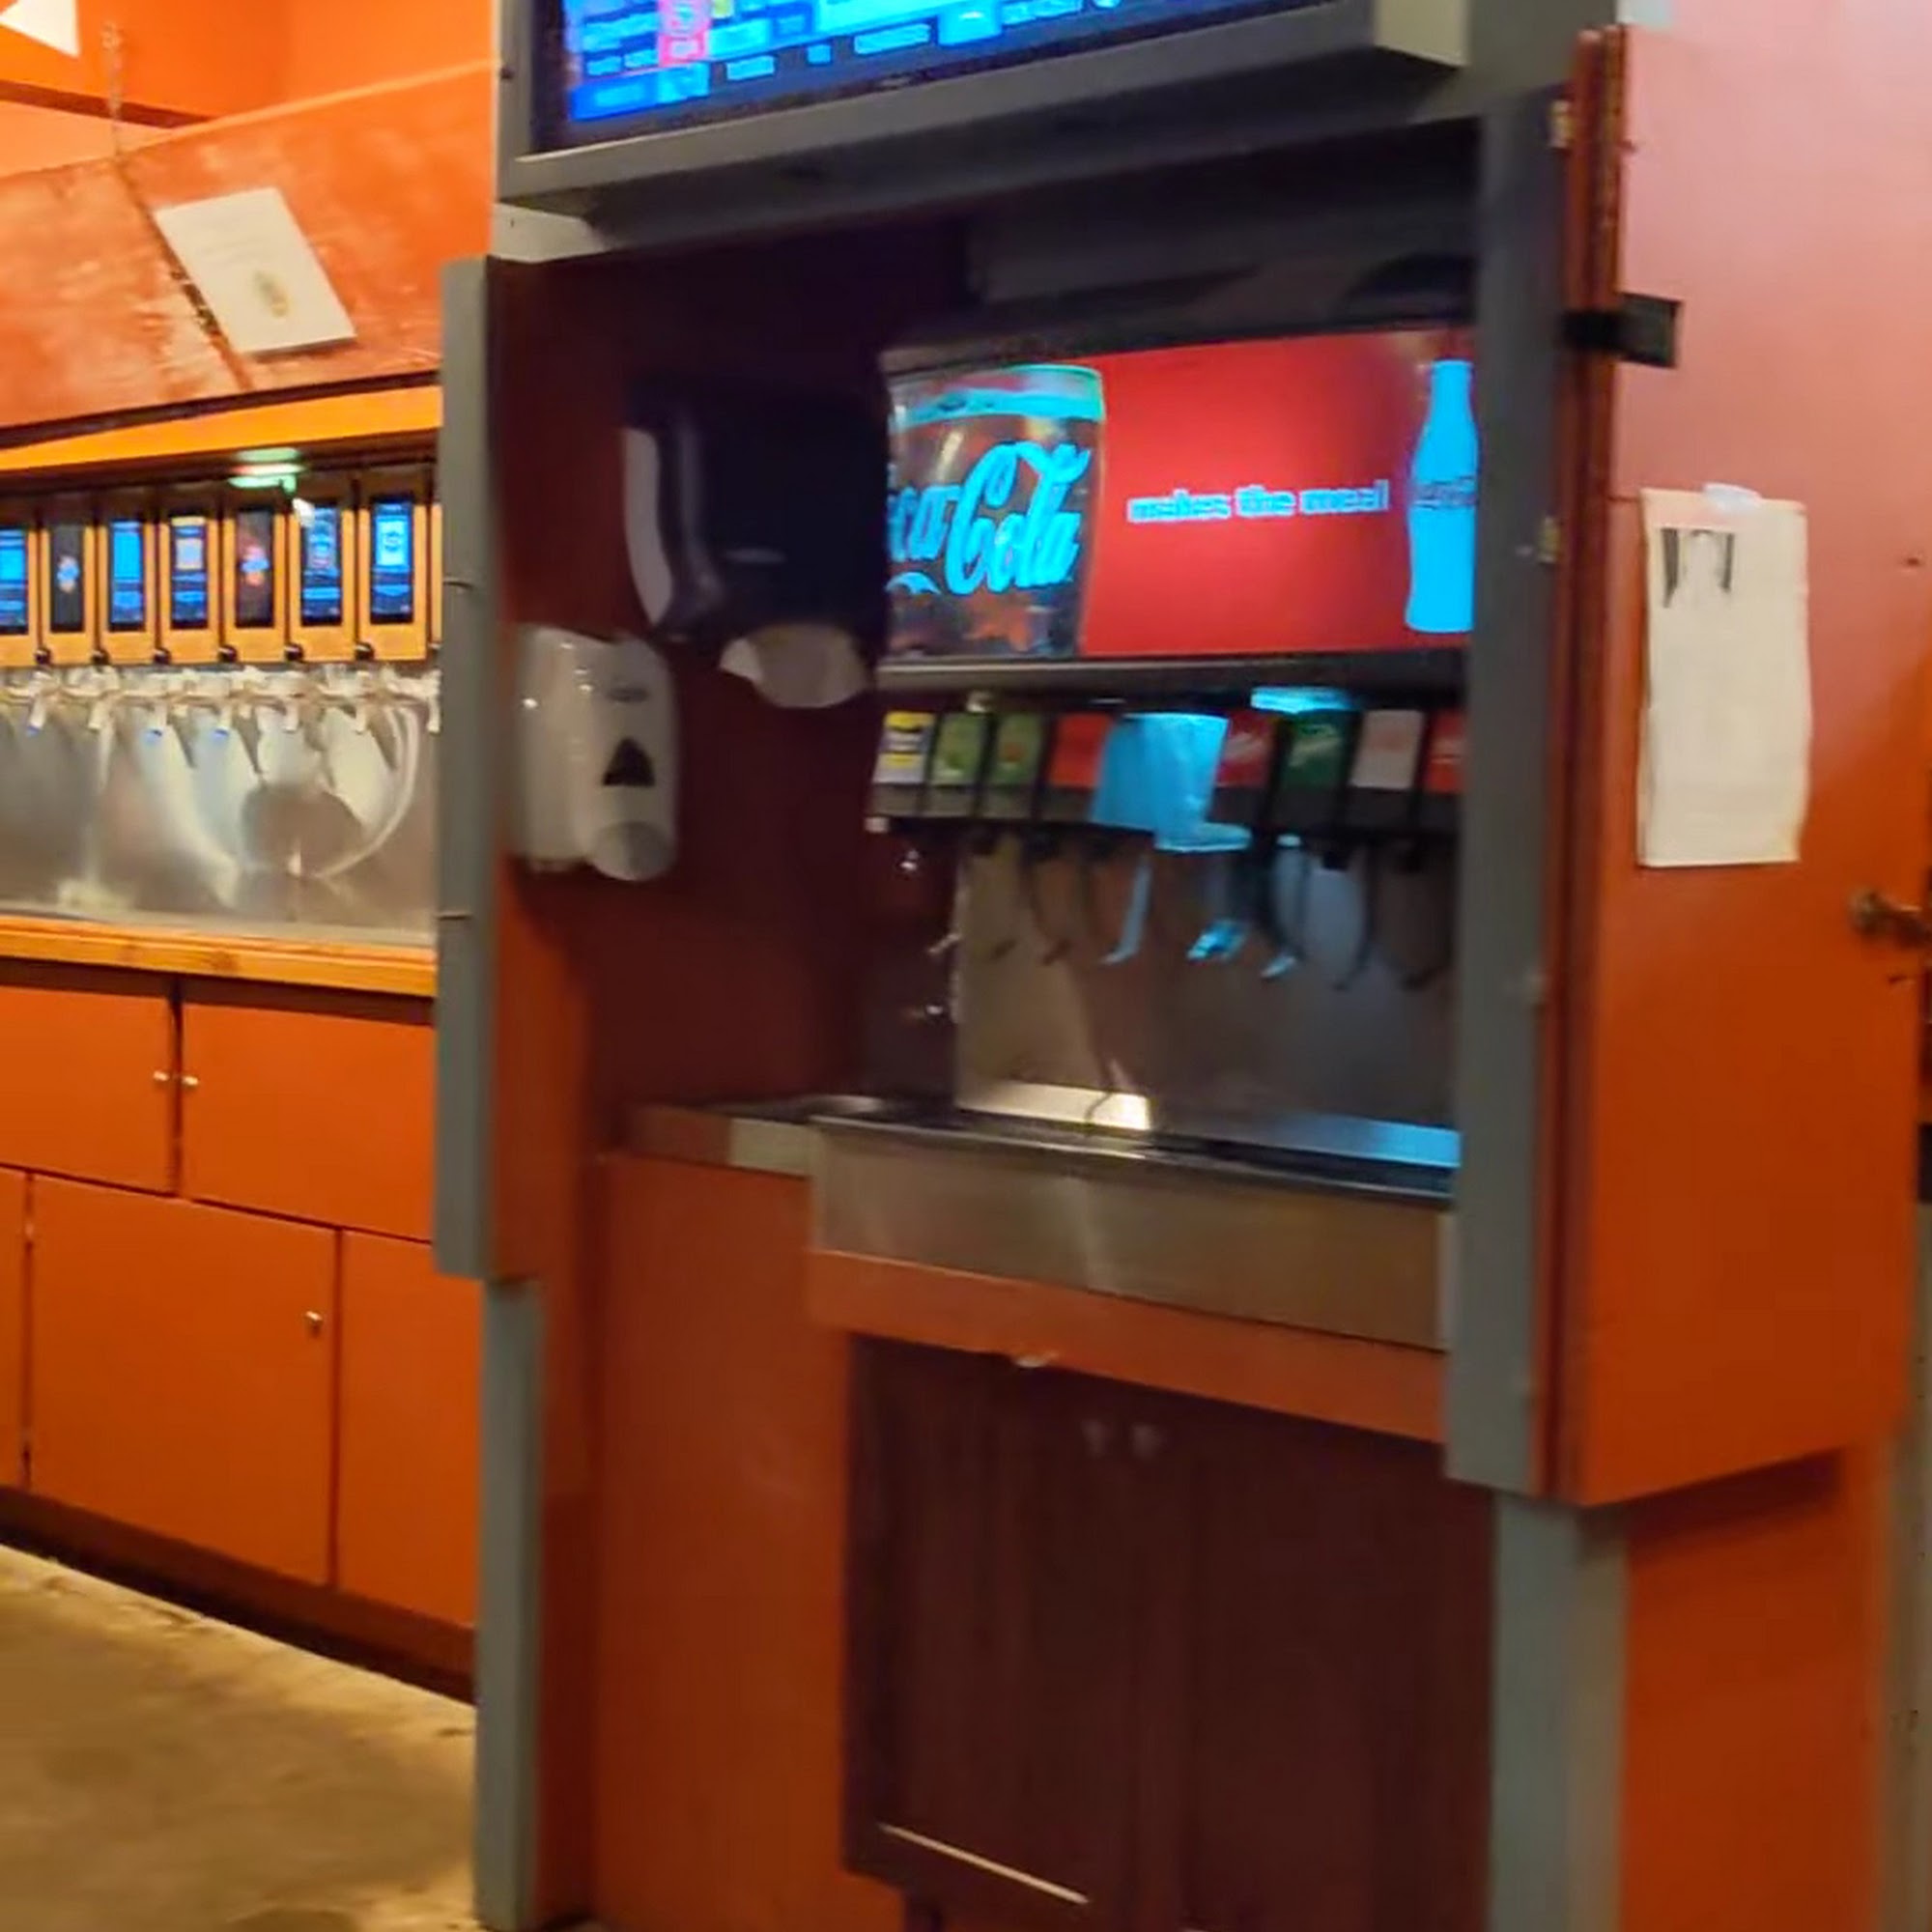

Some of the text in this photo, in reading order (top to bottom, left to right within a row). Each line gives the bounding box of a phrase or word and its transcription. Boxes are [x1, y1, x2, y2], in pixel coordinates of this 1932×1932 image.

[945, 440, 1092, 595] Cola
[1126, 489, 1232, 523] makes
[1235, 485, 1295, 517] the
[1299, 479, 1389, 515] meal
